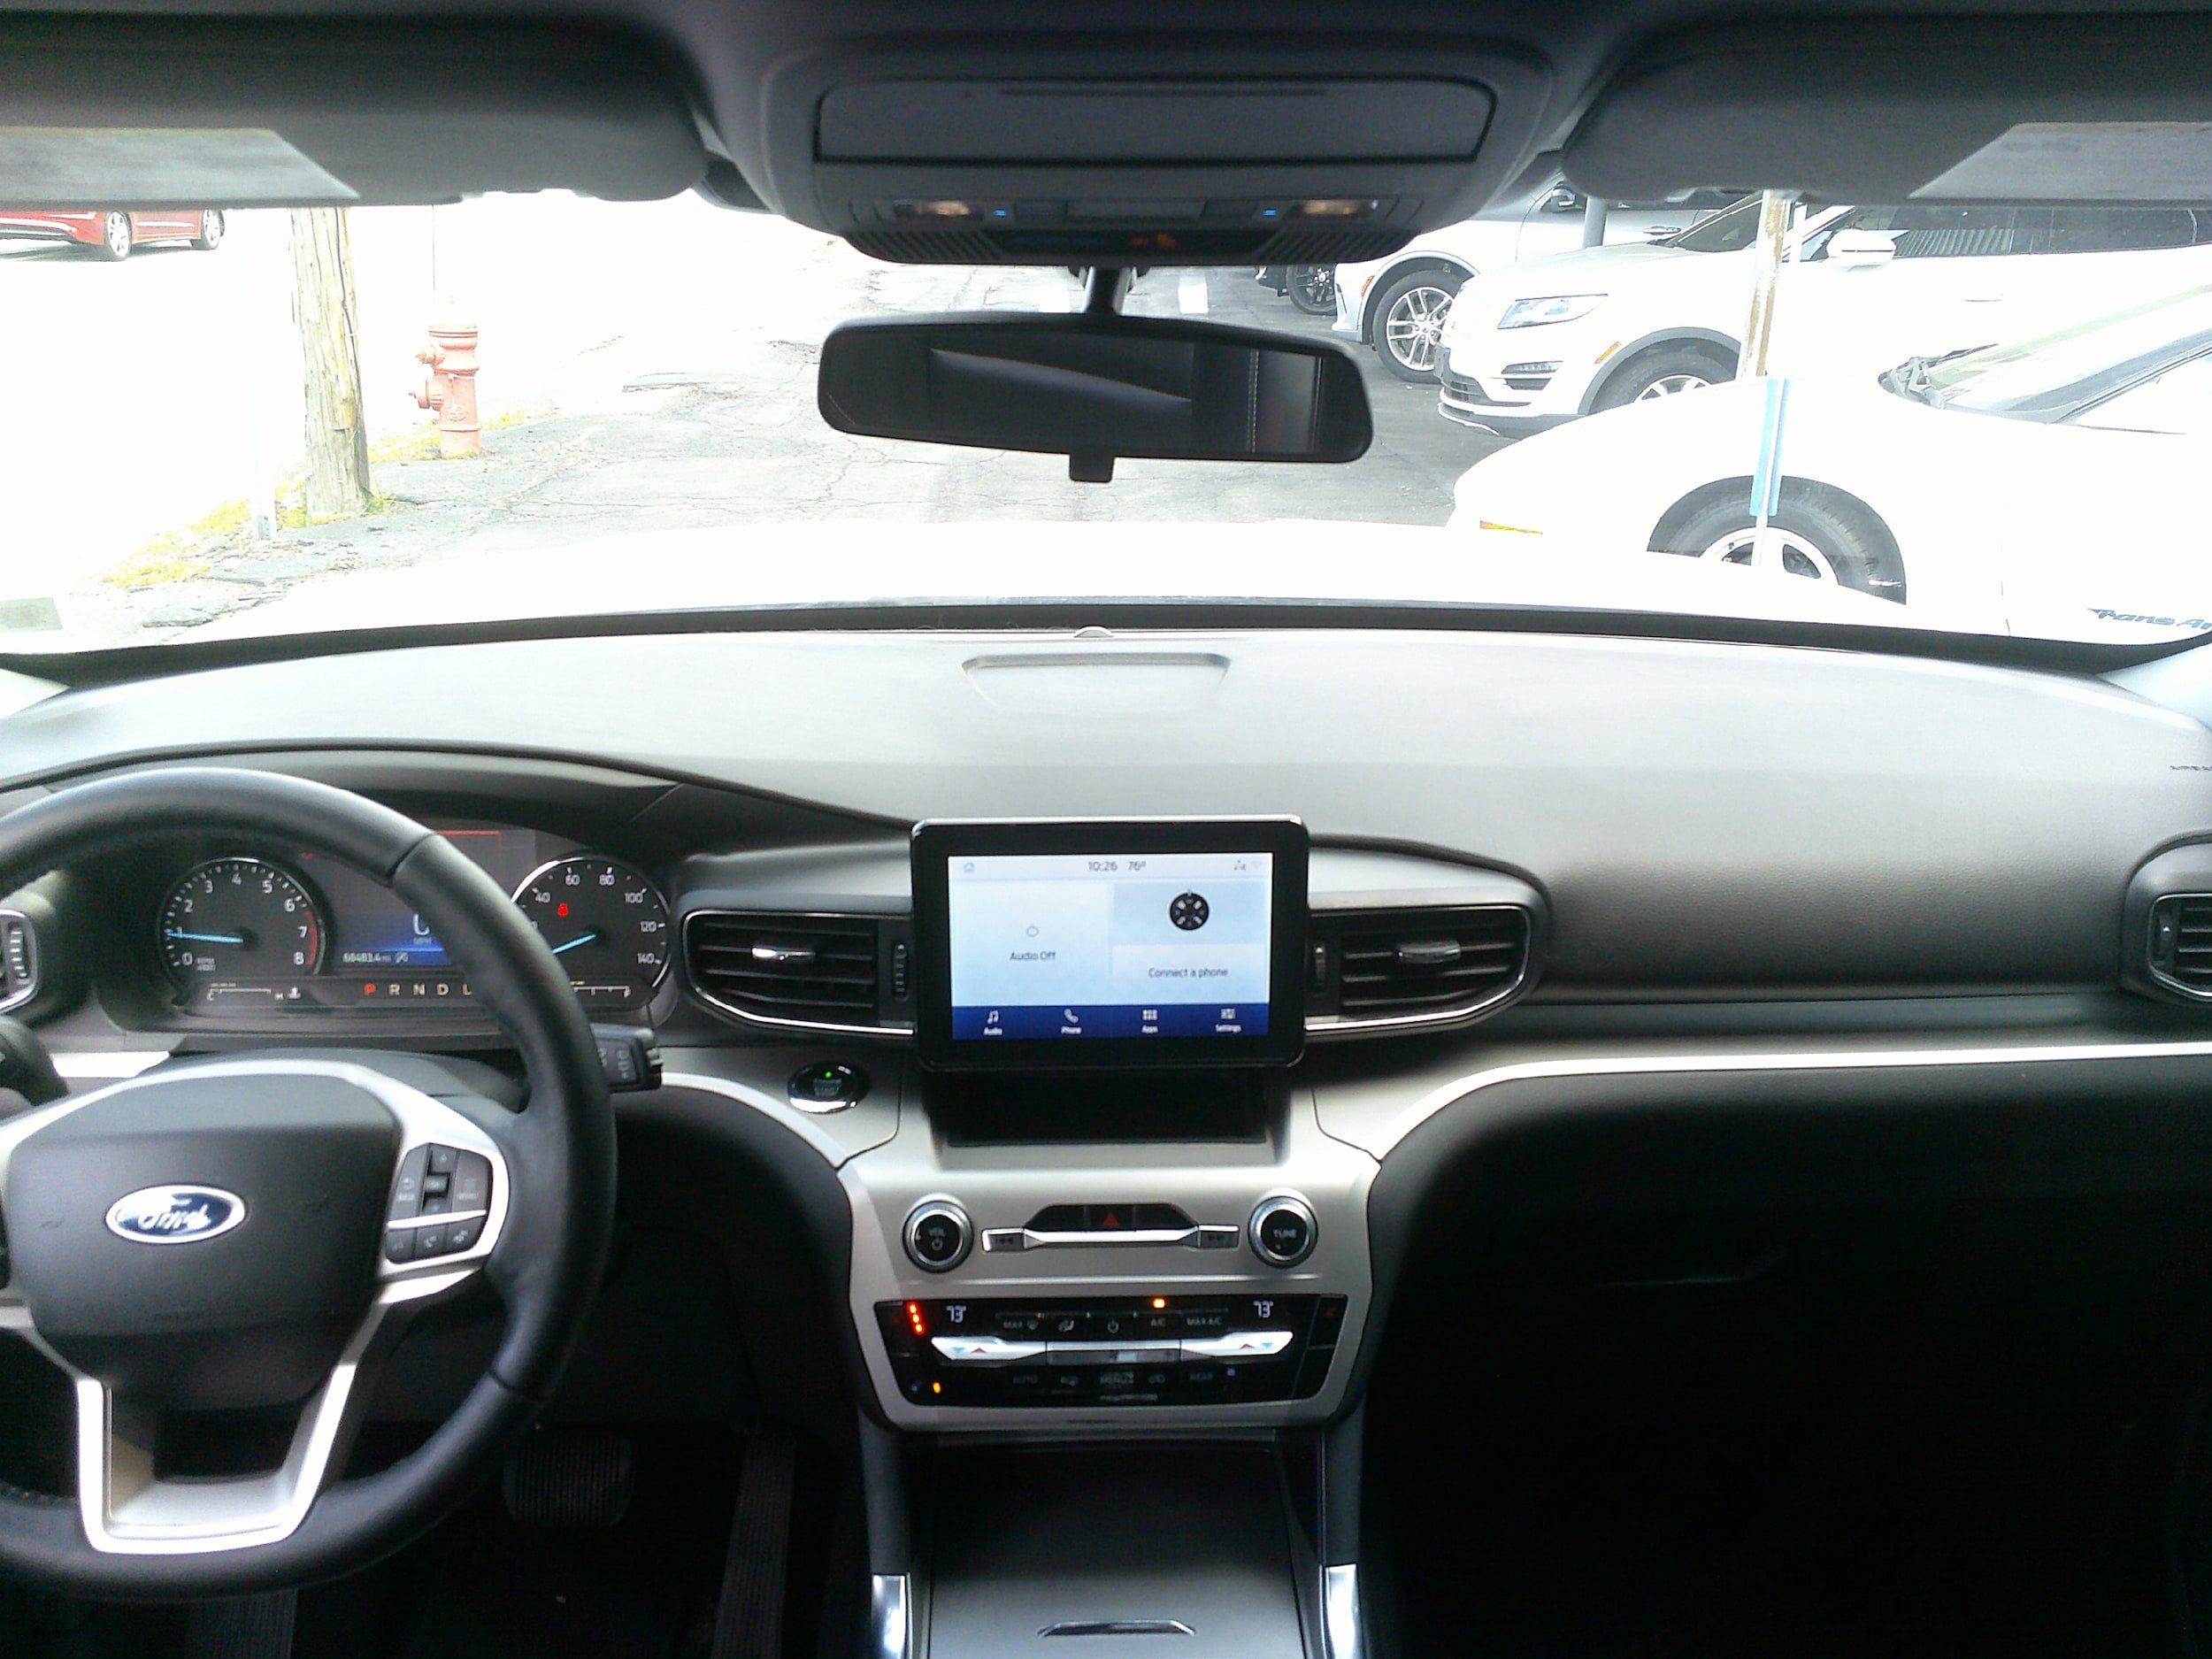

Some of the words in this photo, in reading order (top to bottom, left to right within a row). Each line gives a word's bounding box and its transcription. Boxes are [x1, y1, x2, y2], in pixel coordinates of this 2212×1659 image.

[2086, 607, 2175, 626] Trans
[1087, 861, 1118, 872] 10:26
[231, 873, 242, 886] 4
[565, 874, 580, 886] 60
[599, 874, 615, 886] 80
[204, 879, 213, 894] 3
[262, 879, 273, 894] 5
[534, 892, 551, 903] 40
[625, 893, 643, 904] 100
[183, 899, 194, 912] 2
[284, 898, 296, 912] 6
[297, 926, 307, 939] 7
[641, 921, 657, 933] 120
[181, 952, 193, 966] 0
[293, 951, 304, 965] 8
[637, 953, 655, 964] 140
[1010, 950, 1039, 962] Audio
[1040, 950, 1056, 962] Off
[1148, 967, 1188, 979] Connect
[1198, 967, 1229, 980] phone
[364, 982, 377, 995] P
[389, 983, 402, 996] R
[413, 983, 426, 996] N
[436, 983, 449, 996] D
[983, 1026, 1003, 1036] Audio
[1061, 1025, 1082, 1034] Phone
[1141, 1025, 1158, 1034] Apps
[1215, 1024, 1242, 1034] Settings
[1273, 1228, 1297, 1239] TUNE
